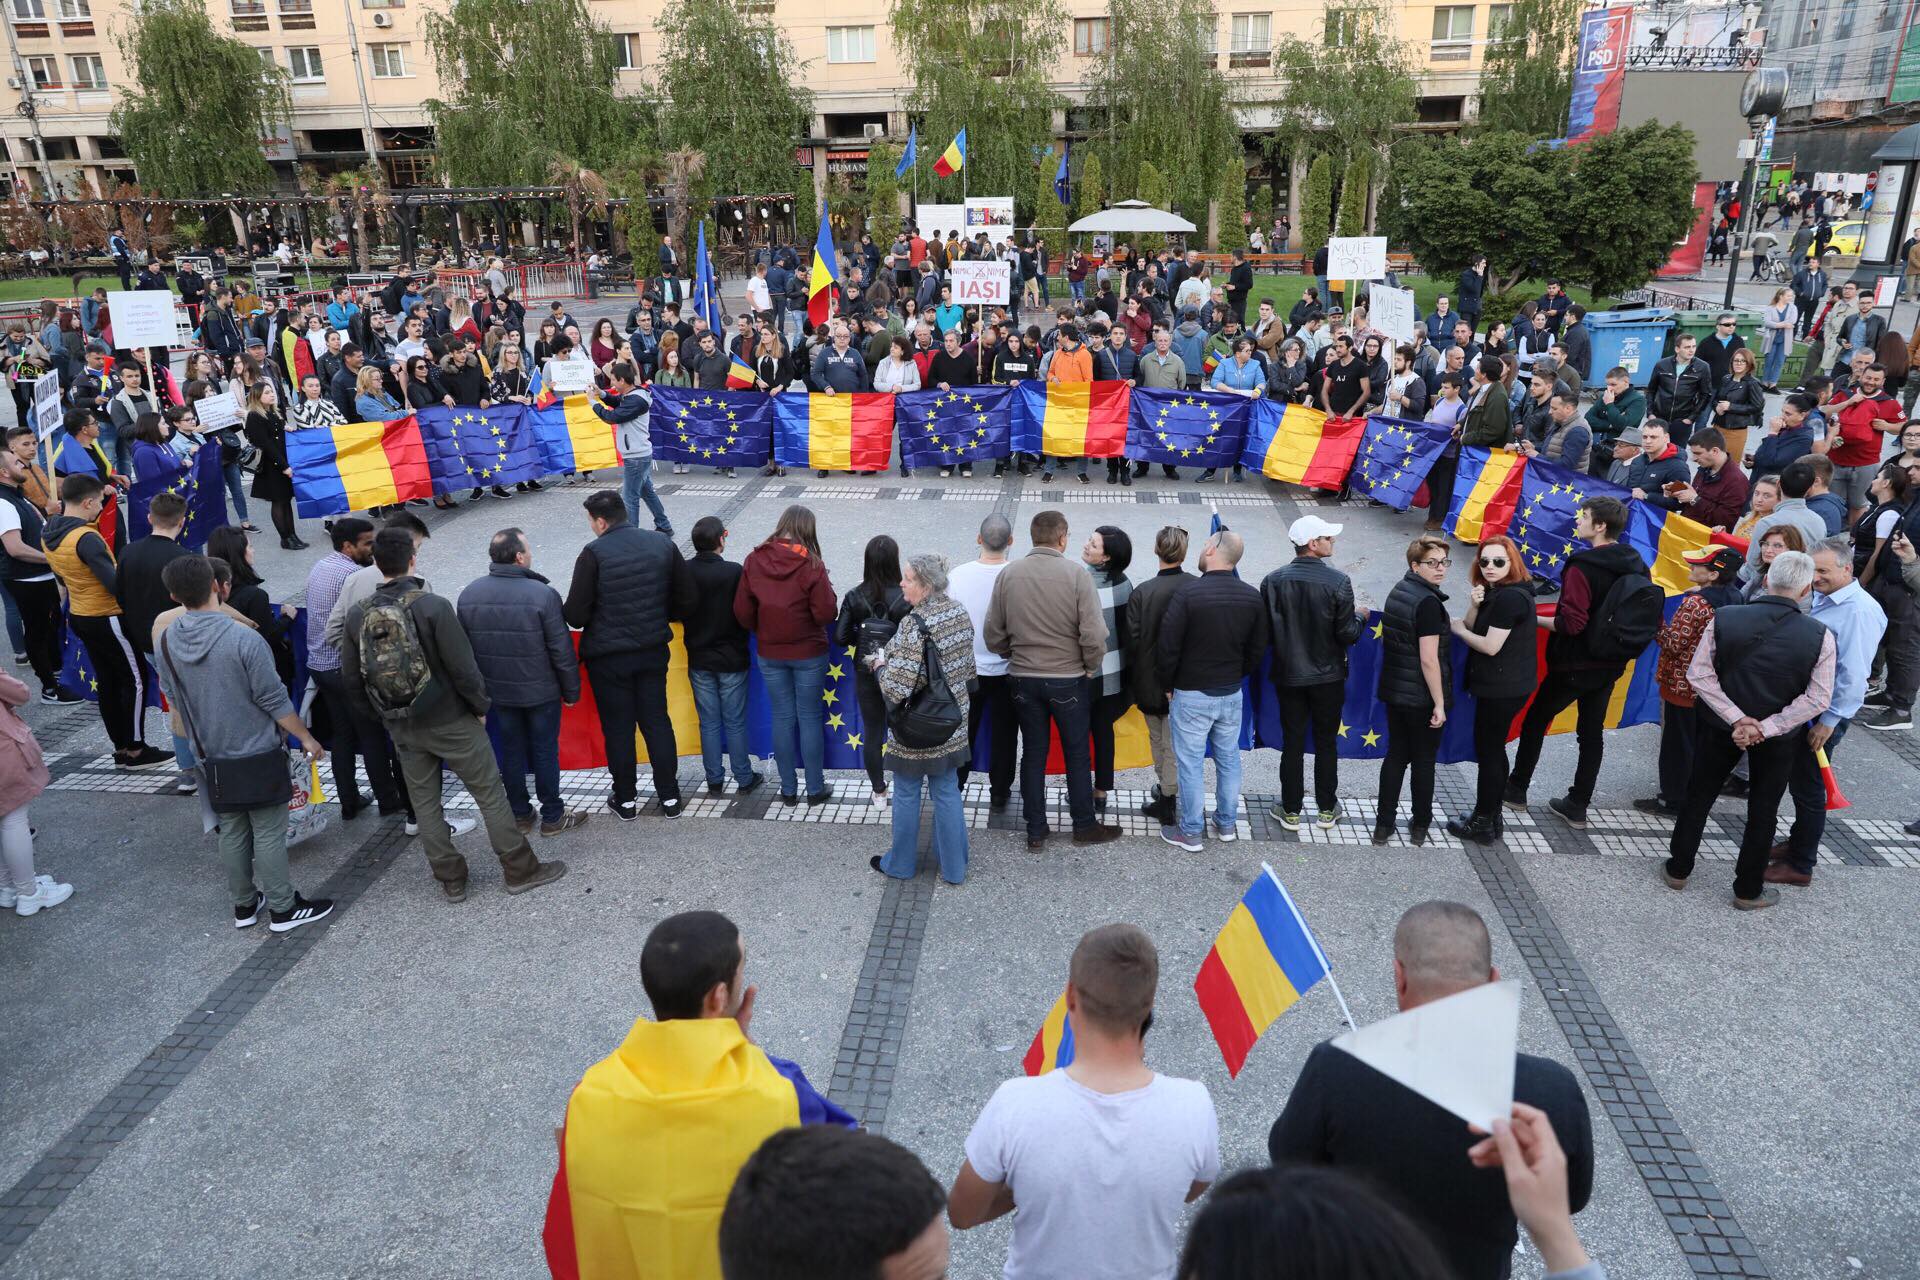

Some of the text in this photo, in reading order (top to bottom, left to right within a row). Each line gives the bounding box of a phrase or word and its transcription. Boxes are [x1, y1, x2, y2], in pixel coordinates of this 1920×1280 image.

[1588, 49, 1613, 66] PSD
[1332, 239, 1377, 256] MUIE
[960, 280, 1001, 303] IAȘI
[1376, 291, 1405, 317] MUIE
[21, 365, 44, 375] PSD
